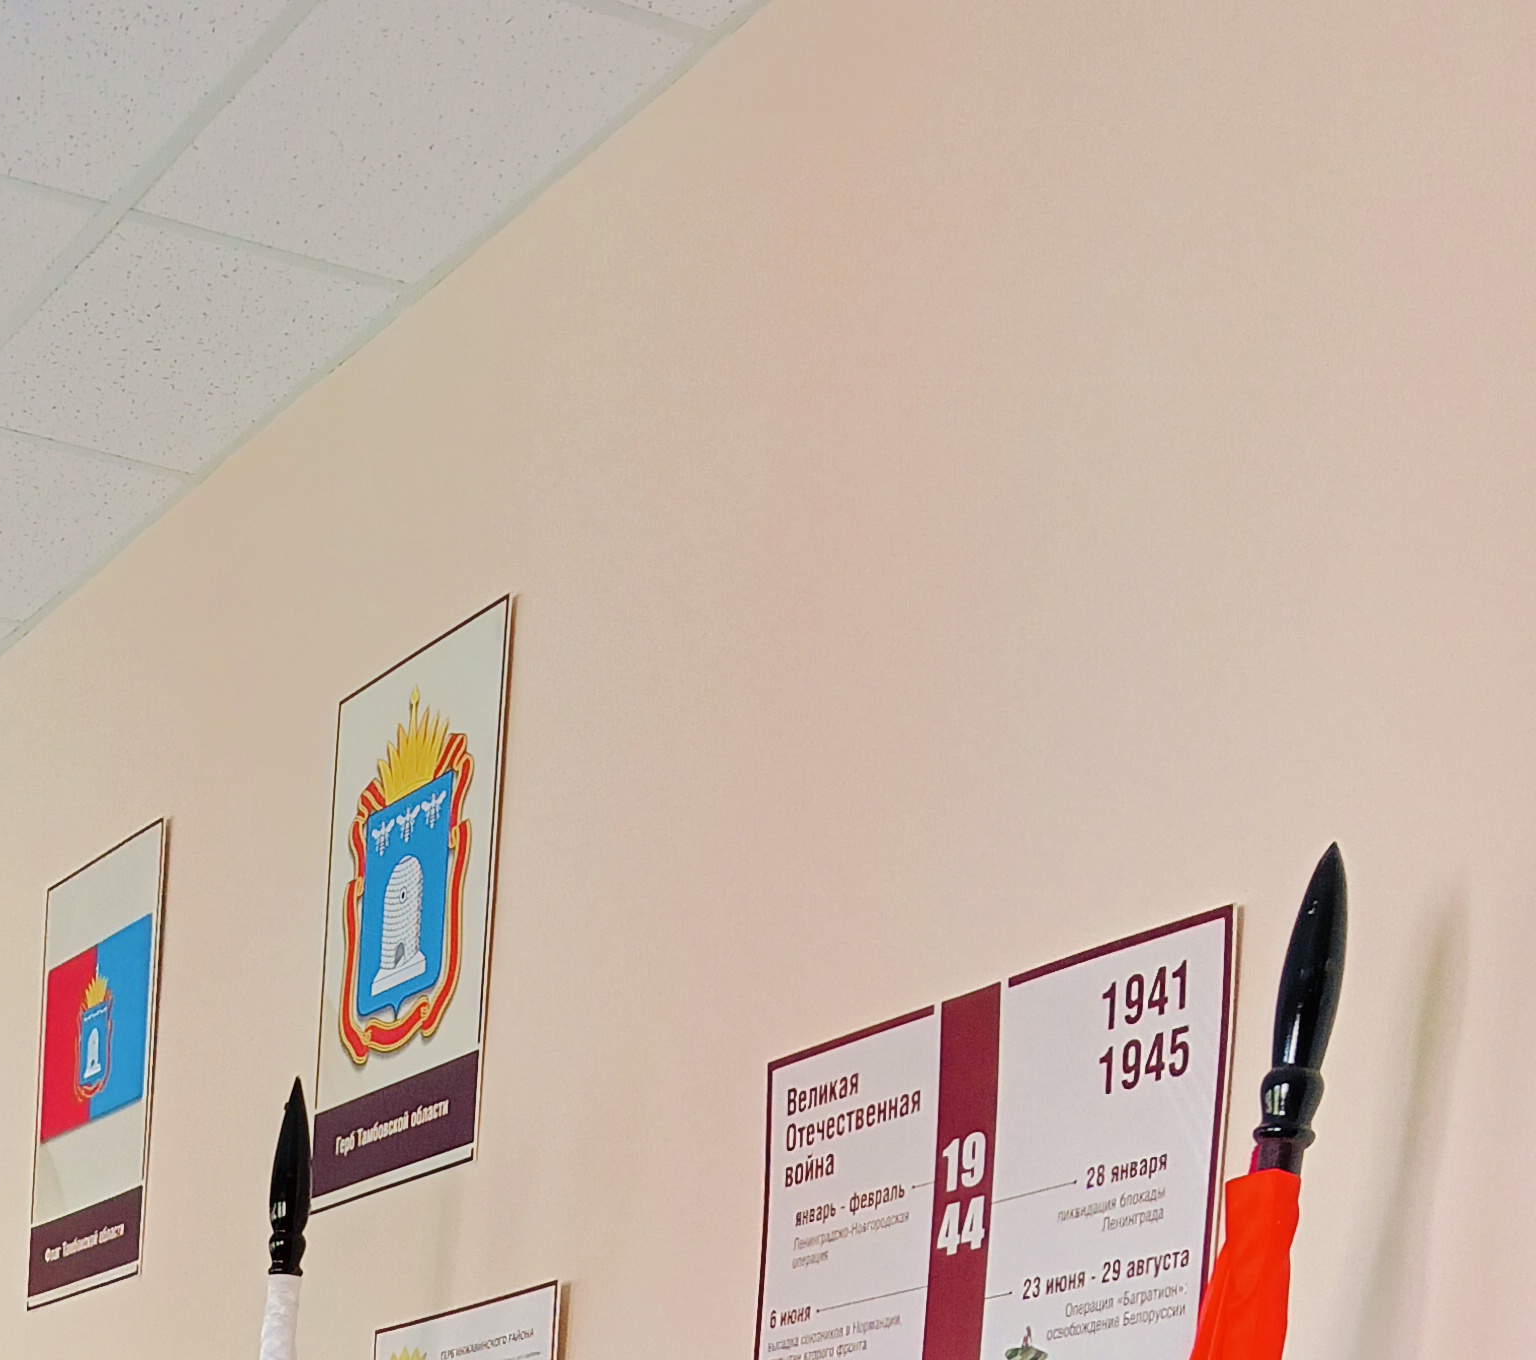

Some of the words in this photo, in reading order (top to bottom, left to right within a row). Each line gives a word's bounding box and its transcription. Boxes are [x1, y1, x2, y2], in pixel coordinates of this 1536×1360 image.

[1102, 960, 1187, 1030] 1941
[1099, 1025, 1190, 1095] 1945
[787, 1073, 859, 1116] Великая
[335, 1131, 355, 1156] Герб
[357, 1111, 409, 1147] Тамбовской
[411, 1099, 449, 1127] области
[786, 1090, 921, 1152] Отечественная
[785, 1153, 835, 1188] война
[942, 1131, 986, 1193] 19
[1086, 1164, 1105, 1189] 28
[1111, 1153, 1168, 1183] января
[795, 1202, 836, 1227] январь
[849, 1183, 905, 1215] февраль
[936, 1195, 985, 1256] 44
[1057, 1195, 1117, 1223] ликвидация
[1119, 1187, 1166, 1209] блокады
[1102, 1207, 1164, 1232] Ленинграда
[1022, 1276, 1040, 1300] 23
[1046, 1271, 1085, 1296] июня
[1102, 1259, 1121, 1284] 29
[1126, 1249, 1190, 1279] августа
[770, 1310, 776, 1328] 6
[780, 1306, 811, 1327] июня
[1046, 1317, 1119, 1341] освобождение
[1123, 1304, 1185, 1328] Белоруссии
[1065, 1295, 1114, 1318] Операция
